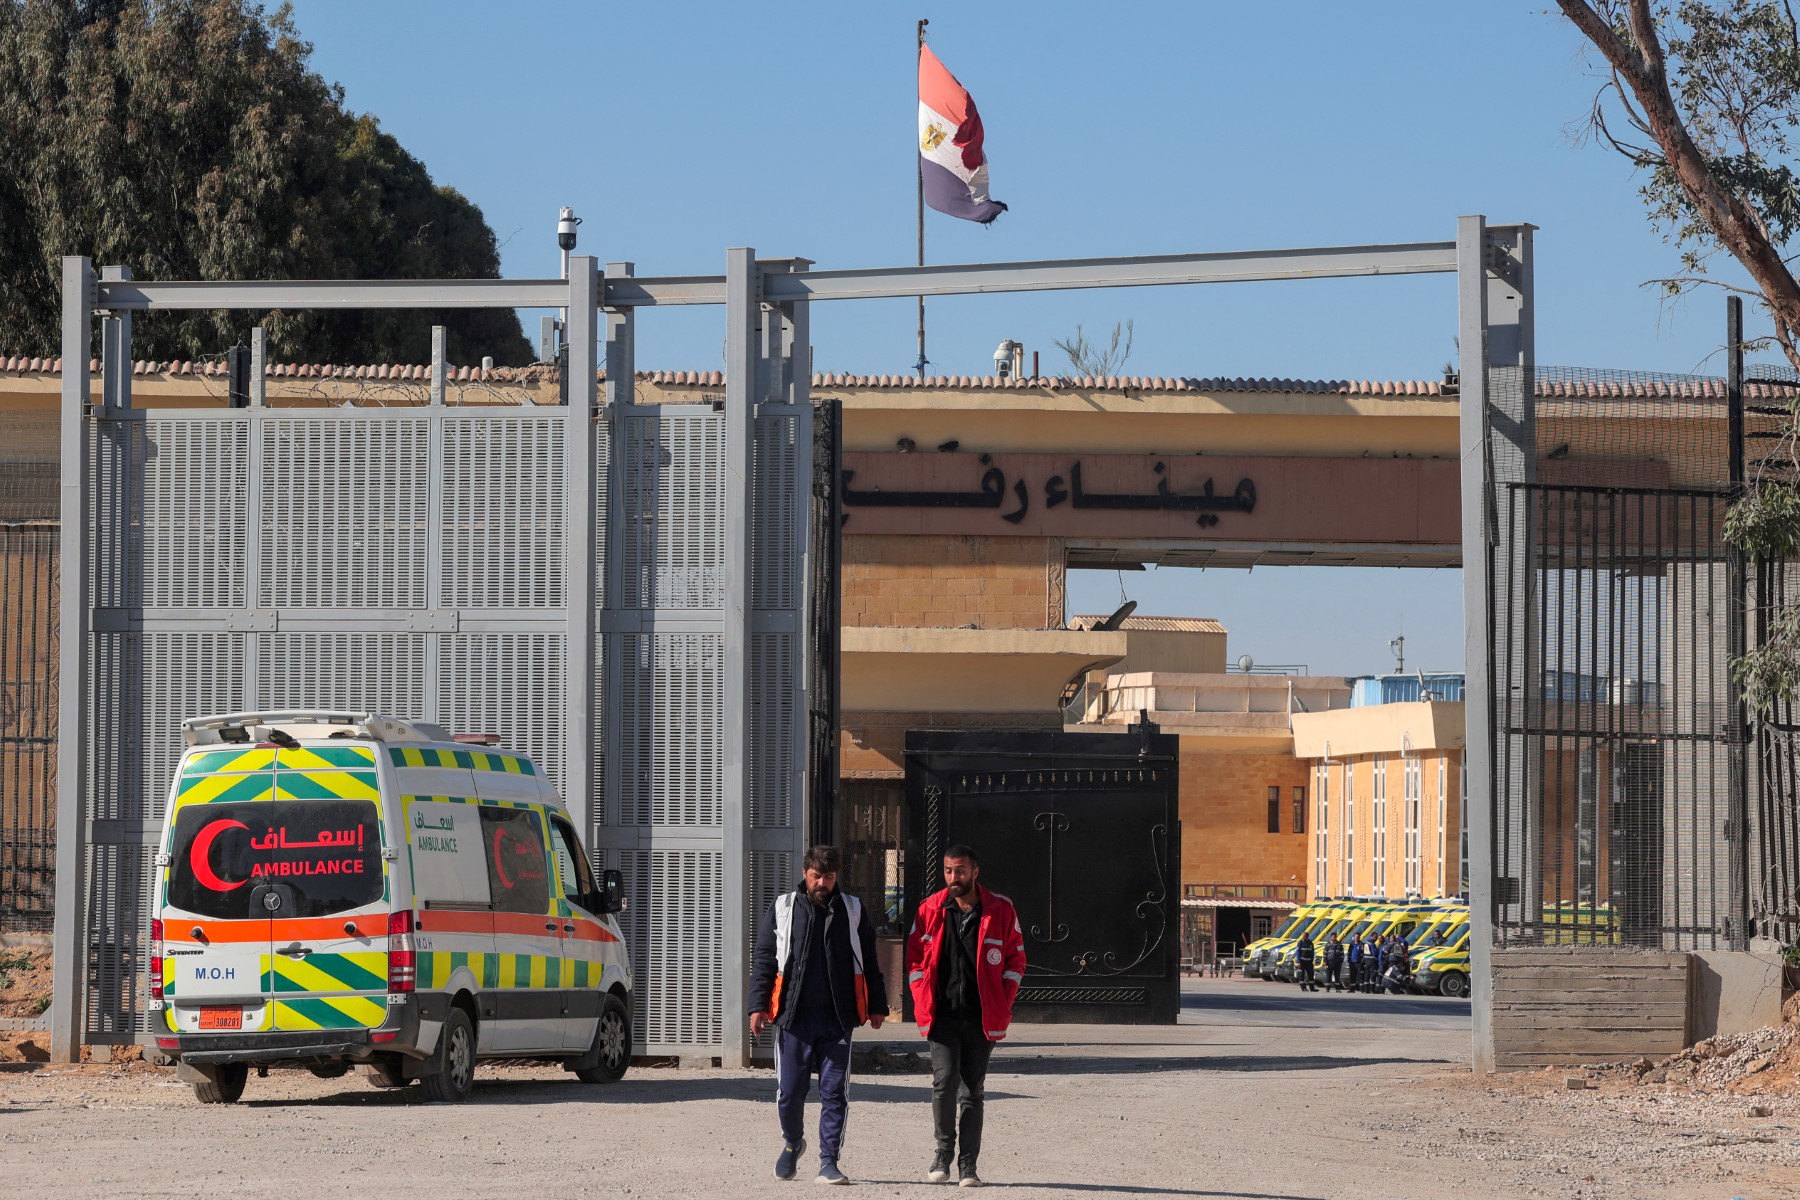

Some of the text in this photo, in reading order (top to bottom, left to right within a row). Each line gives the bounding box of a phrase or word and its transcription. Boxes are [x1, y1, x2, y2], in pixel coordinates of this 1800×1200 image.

[1045, 461, 1257, 529] ميناء
[251, 824, 364, 852] إسعاف
[418, 836, 458, 853] AMBULANCE
[251, 859, 364, 877] AMBULANCE
[195, 967, 235, 980] M.O.H
[215, 1017, 240, 1027] 308281
